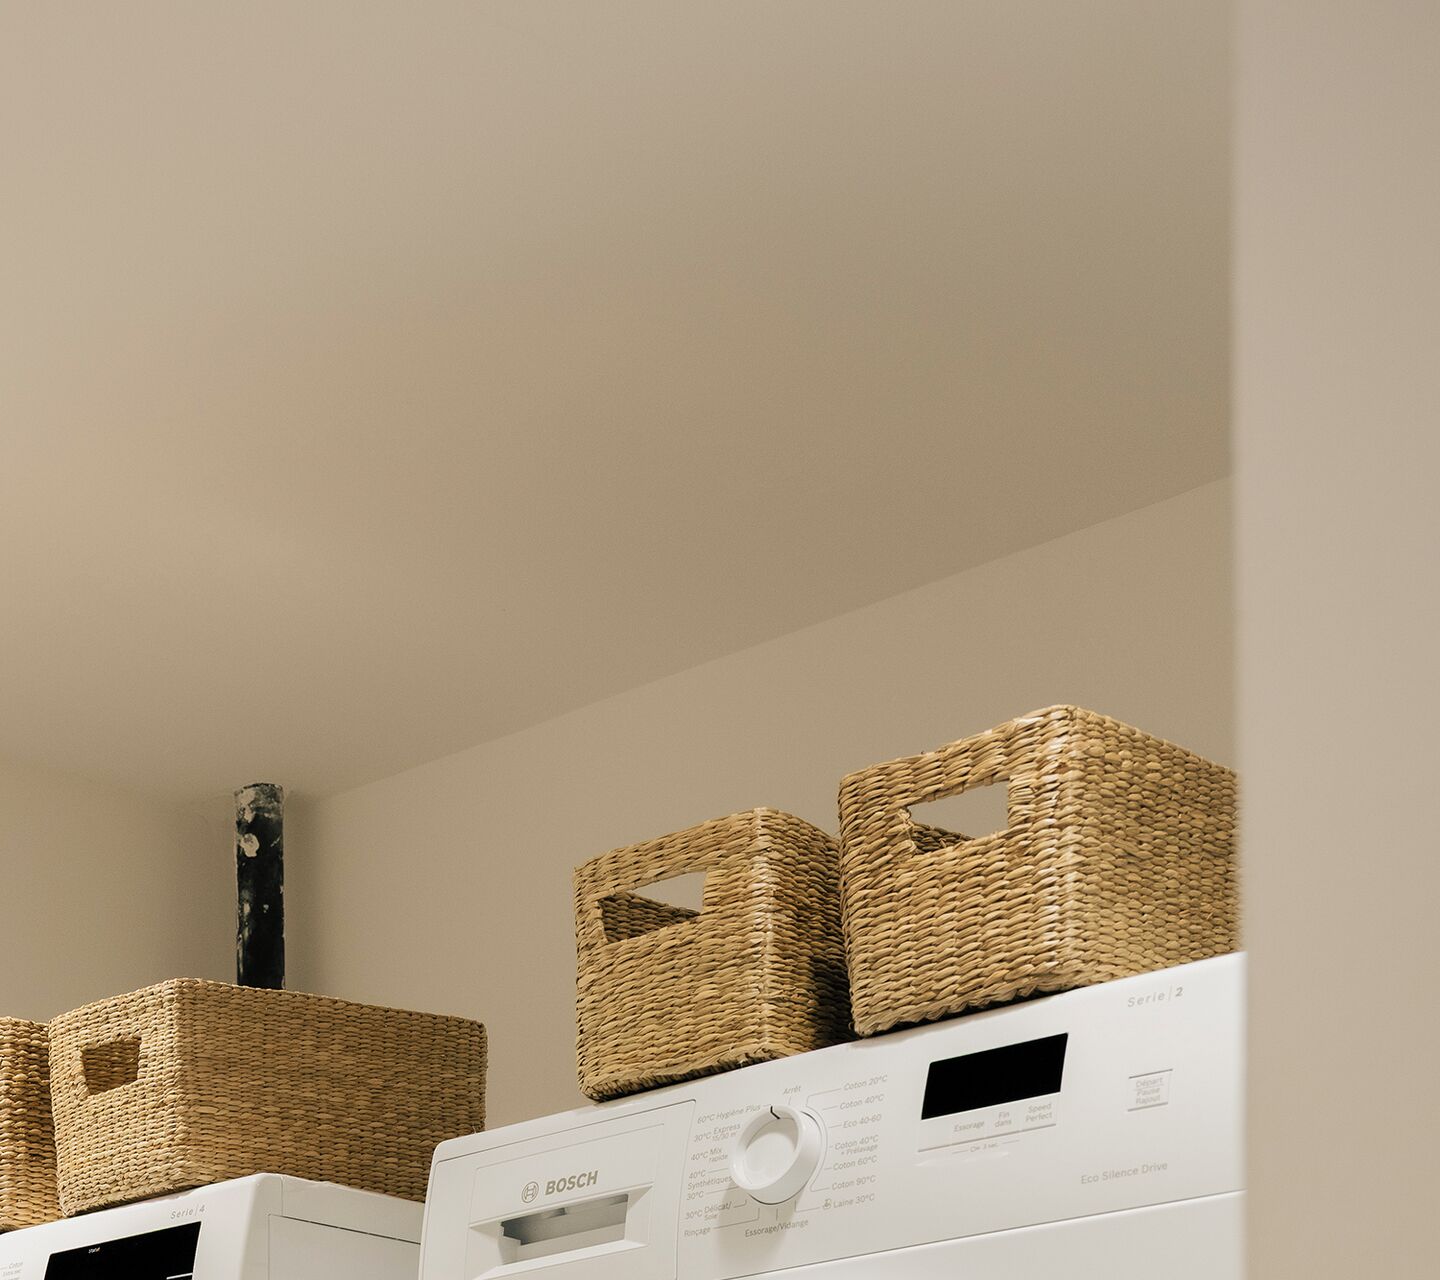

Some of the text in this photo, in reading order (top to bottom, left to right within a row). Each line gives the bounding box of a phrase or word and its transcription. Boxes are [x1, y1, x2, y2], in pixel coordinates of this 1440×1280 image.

[1127, 986, 1184, 1007] Serie 2
[843, 1074, 887, 1091] Coton 20°C
[783, 1085, 801, 1095] Arrêt
[840, 1094, 884, 1110] Coton 40°C
[1028, 1102, 1052, 1113] Speed
[697, 1104, 760, 1124] 60°C Hygiène Plus
[843, 1114, 882, 1128] Eco 40-60
[1025, 1112, 1052, 1122] Perfect
[953, 1121, 984, 1132] Essorage
[994, 1119, 1012, 1128] dans
[694, 1131, 712, 1142] 30°C
[713, 1124, 741, 1136] Express
[835, 1135, 879, 1151] Coton 40°C
[691, 1151, 708, 1161] 40°C
[709, 1147, 722, 1155] Mix
[833, 1155, 877, 1171] Coton 60°C
[689, 1169, 706, 1179] 40°C
[1081, 1162, 1168, 1184] Eco Silence Drive
[545, 1170, 599, 1196] BOSCH
[687, 1175, 732, 1189] Synthétiques
[832, 1175, 876, 1190] Coton 90°C
[687, 1190, 704, 1200] 30°C
[833, 1193, 875, 1208] Laine 30°C
[170, 1208, 193, 1220] Serie
[686, 1209, 703, 1219] 30°C
[745, 1219, 808, 1237] Essorage/Vidange
